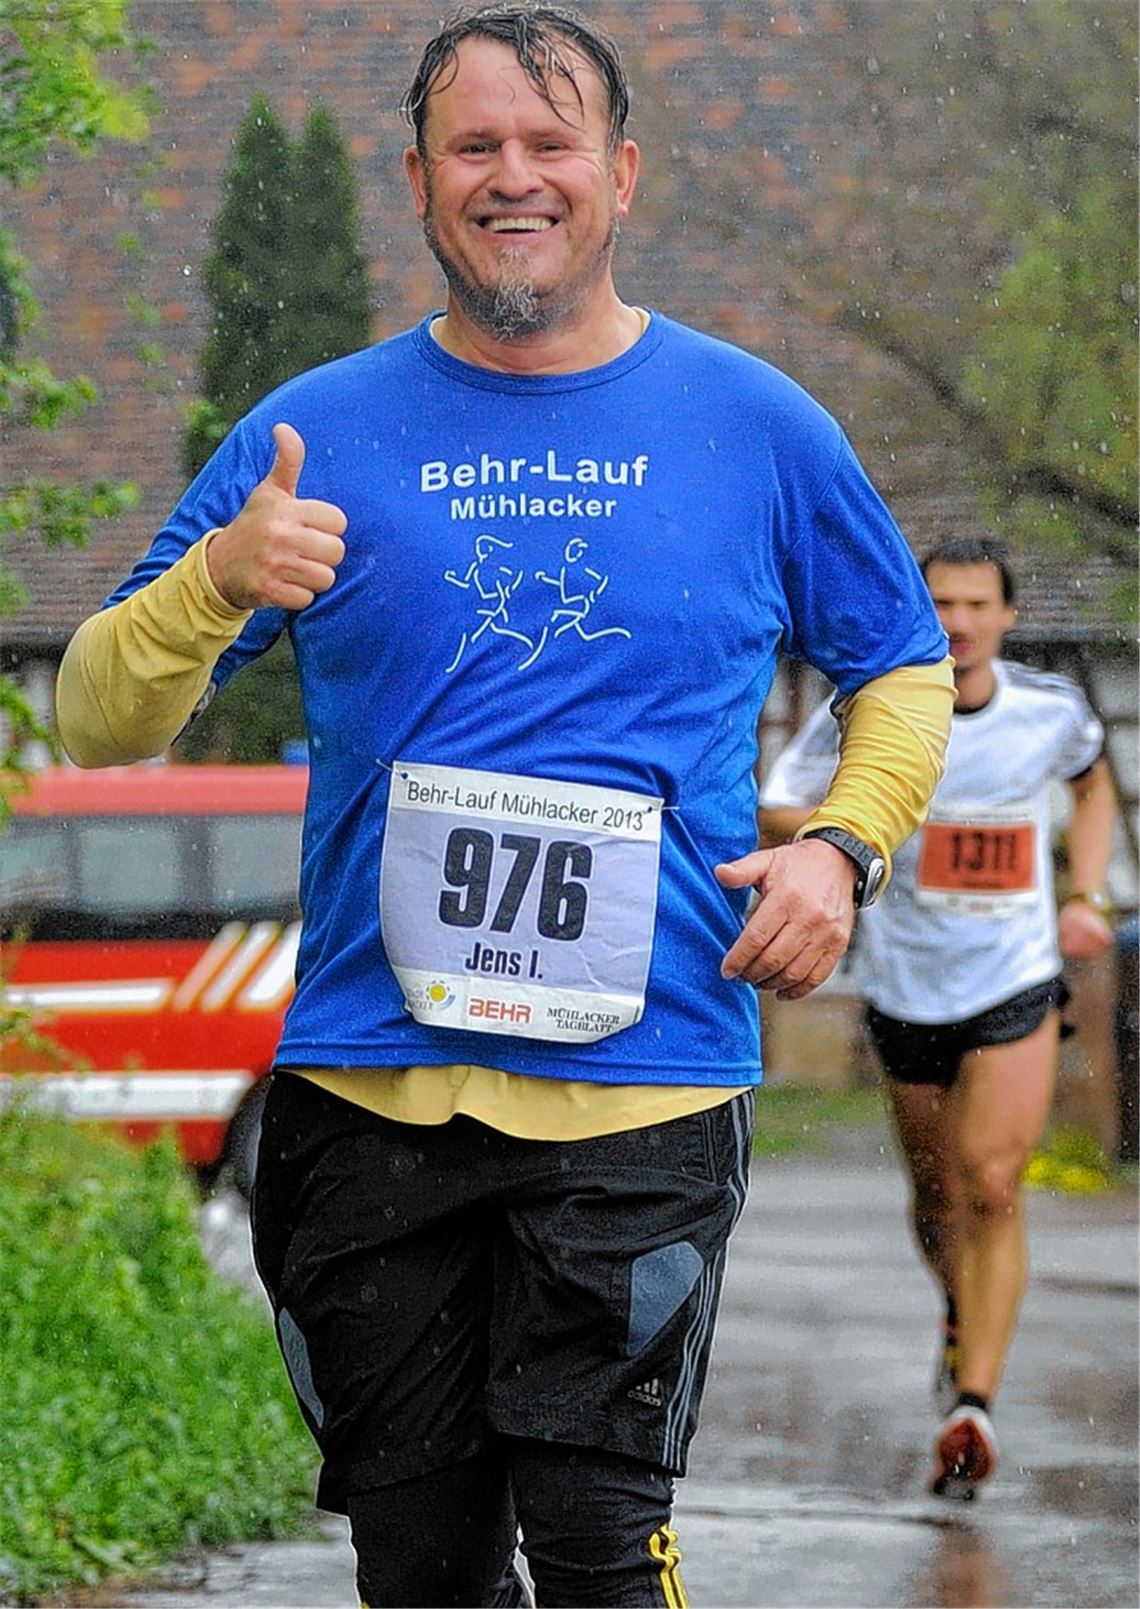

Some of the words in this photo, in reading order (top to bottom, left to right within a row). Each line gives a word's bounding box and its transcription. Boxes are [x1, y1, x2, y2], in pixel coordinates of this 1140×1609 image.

[420, 450, 649, 493] Behr-Lauf
[450, 493, 617, 520] Mühlacker
[407, 781, 496, 811] Behr-Lauf
[502, 793, 598, 825] Mühlacker
[602, 806, 643, 831] 2013
[439, 828, 592, 940] 976
[465, 942, 521, 976] Jens
[469, 998, 532, 1023] BEHR
[546, 1007, 620, 1025] MÜHLACKER
[555, 1018, 613, 1033] TAGBLATT
